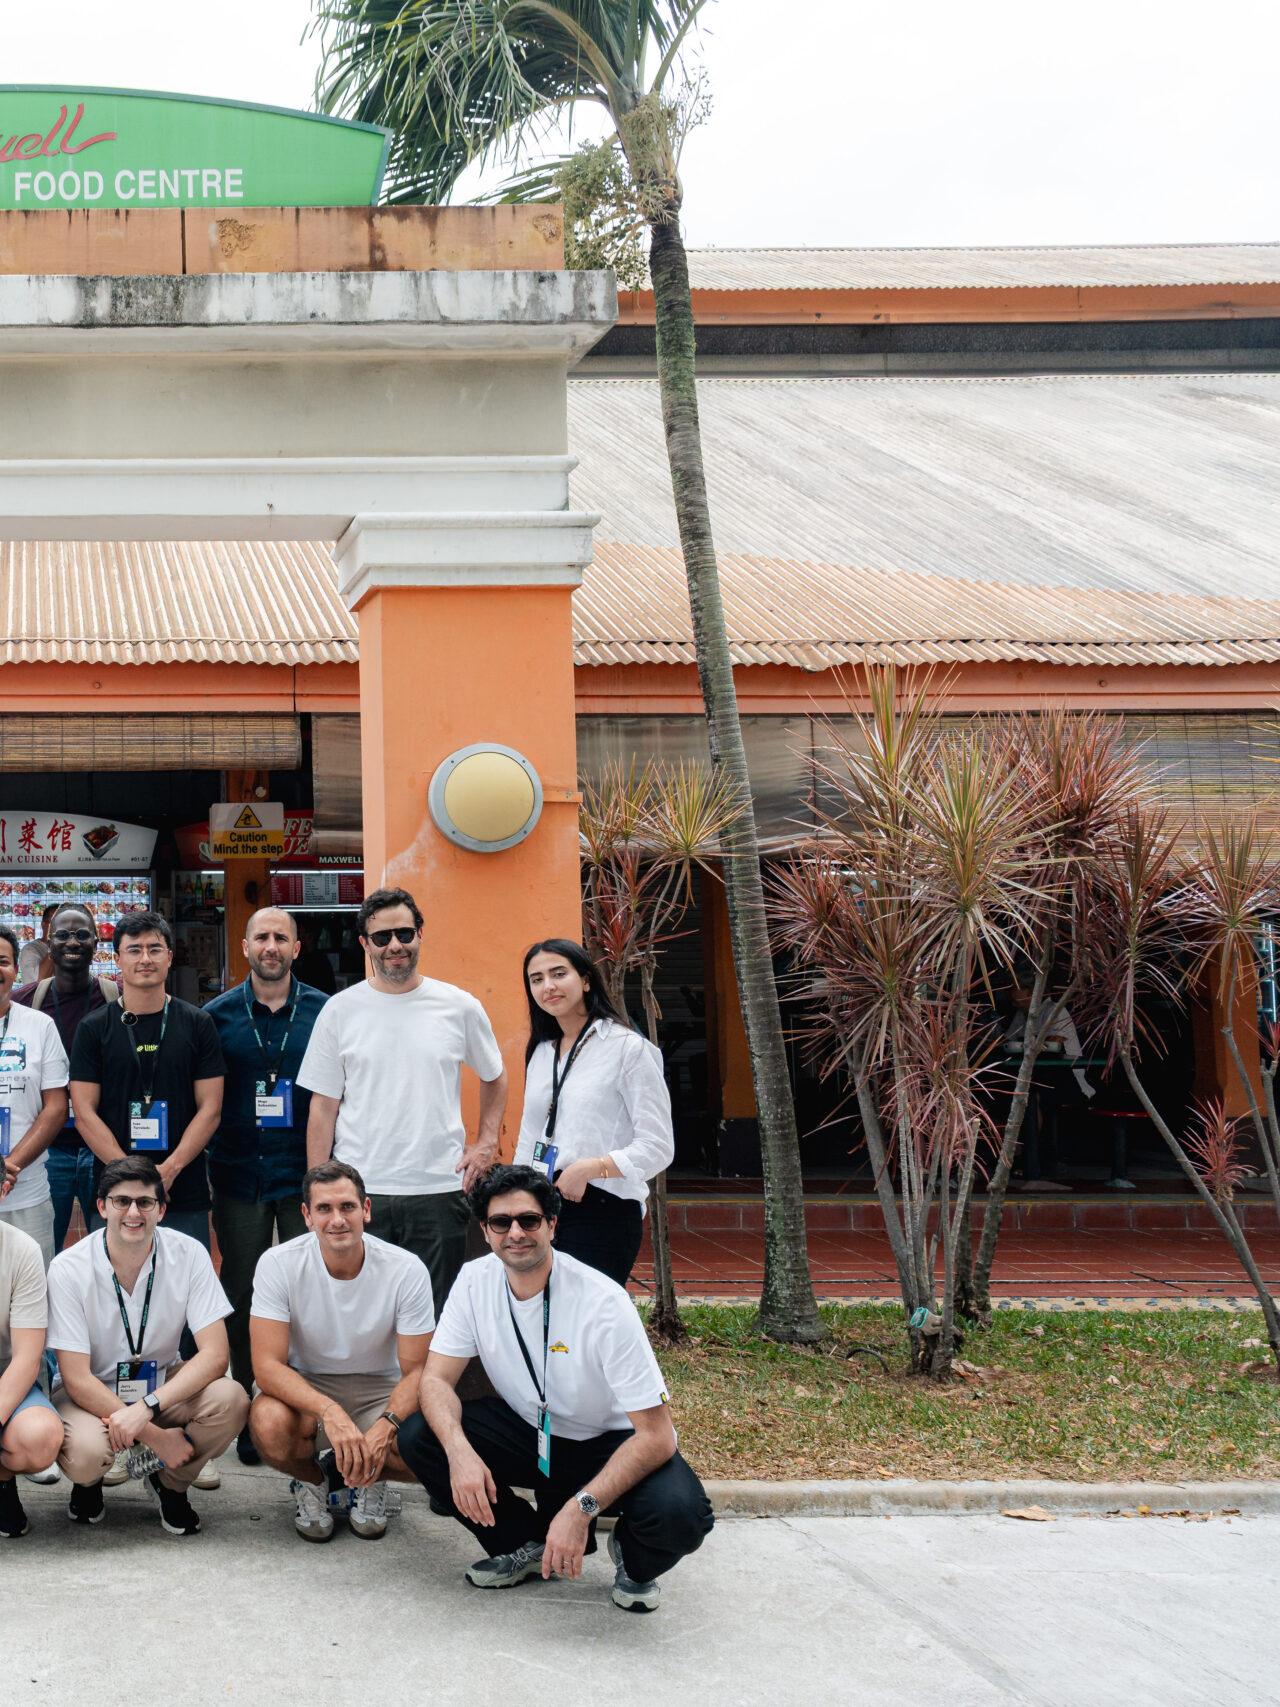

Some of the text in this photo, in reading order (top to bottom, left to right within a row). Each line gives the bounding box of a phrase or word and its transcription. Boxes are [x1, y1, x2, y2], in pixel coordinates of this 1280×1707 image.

[14, 168, 244, 202] FOOD CENTRE
[229, 831, 267, 843] Caution
[214, 843, 284, 856] Mind the step
[17, 855, 59, 864] CUISINE
[318, 855, 363, 864] MAXWELL
